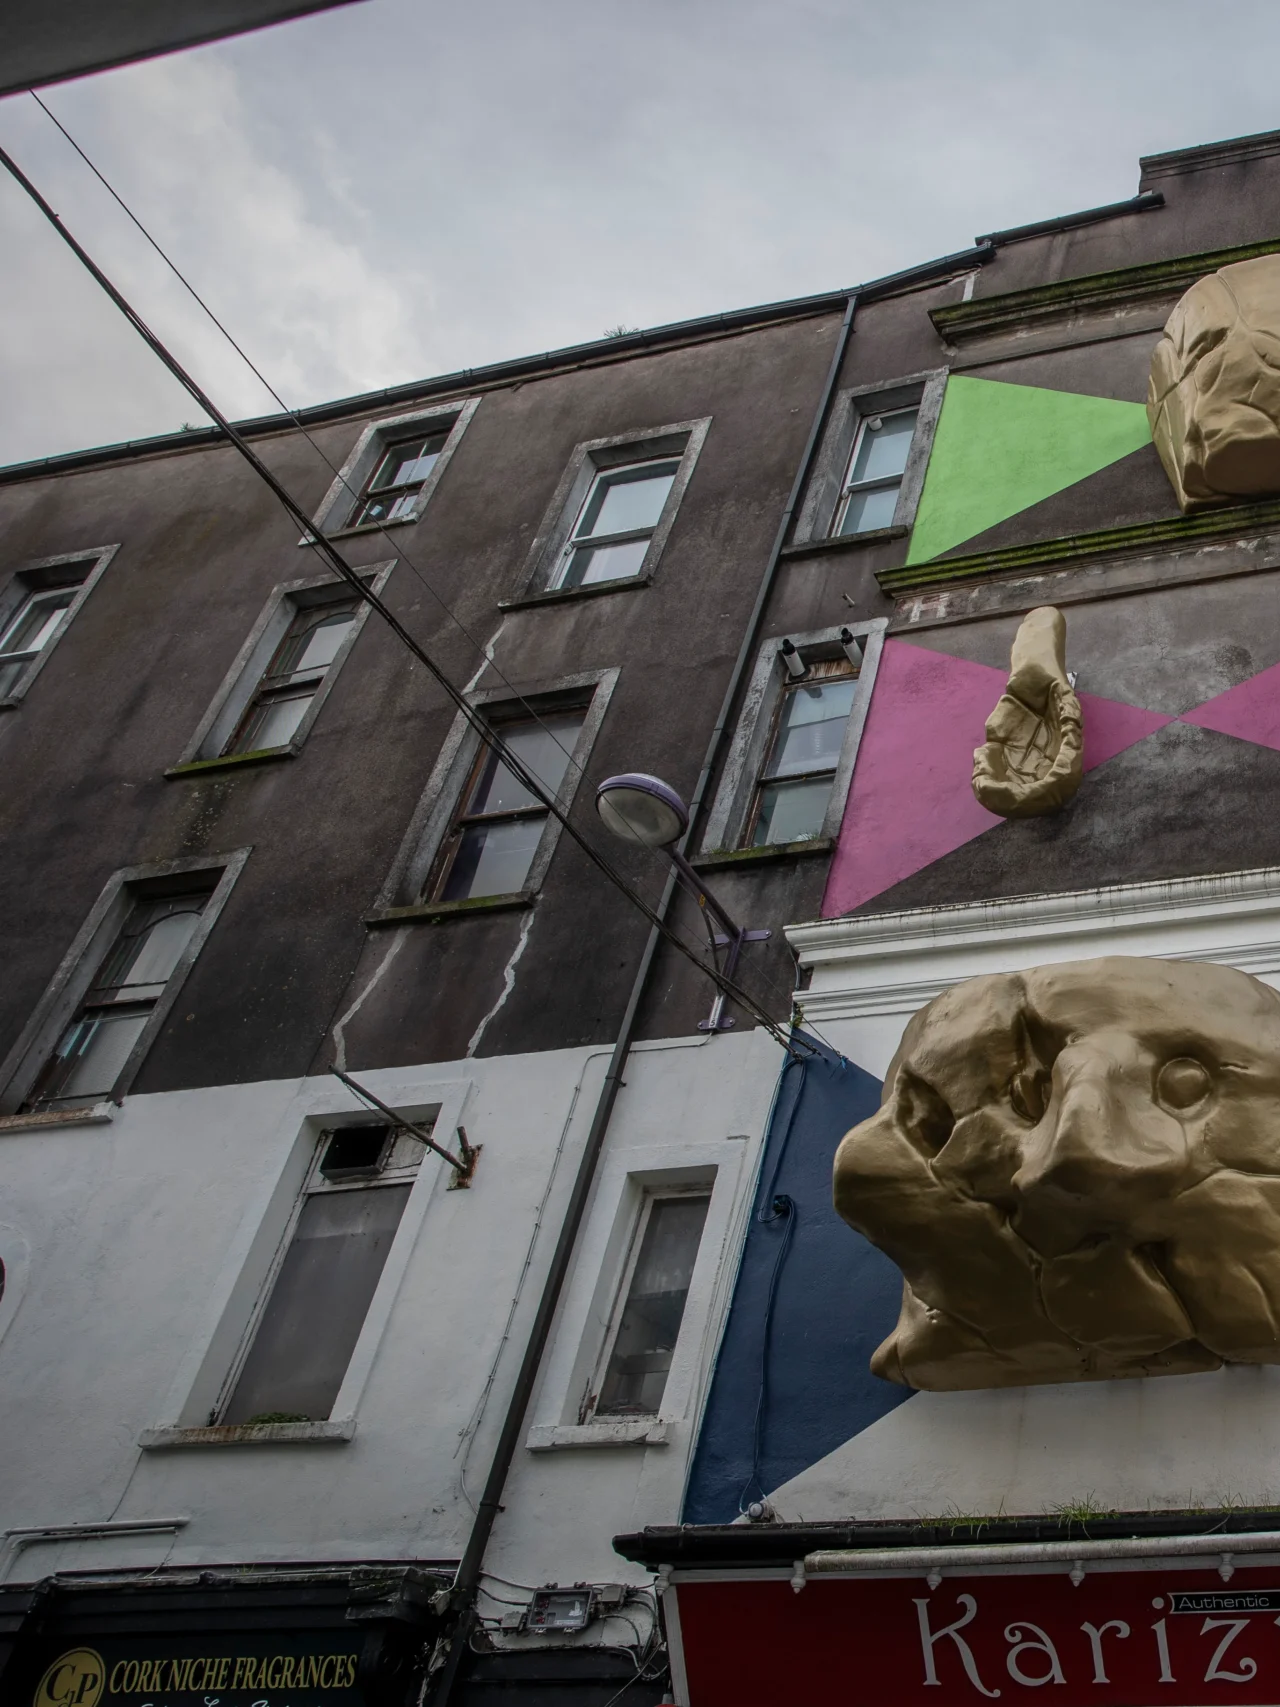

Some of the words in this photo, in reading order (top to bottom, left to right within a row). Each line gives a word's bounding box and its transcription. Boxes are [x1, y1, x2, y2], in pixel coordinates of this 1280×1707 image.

[1179, 1593, 1270, 1610] Authentic
[109, 1660, 168, 1693] CORK
[167, 1657, 232, 1691] NICHE
[230, 1654, 358, 1690] FRAGRANCES
